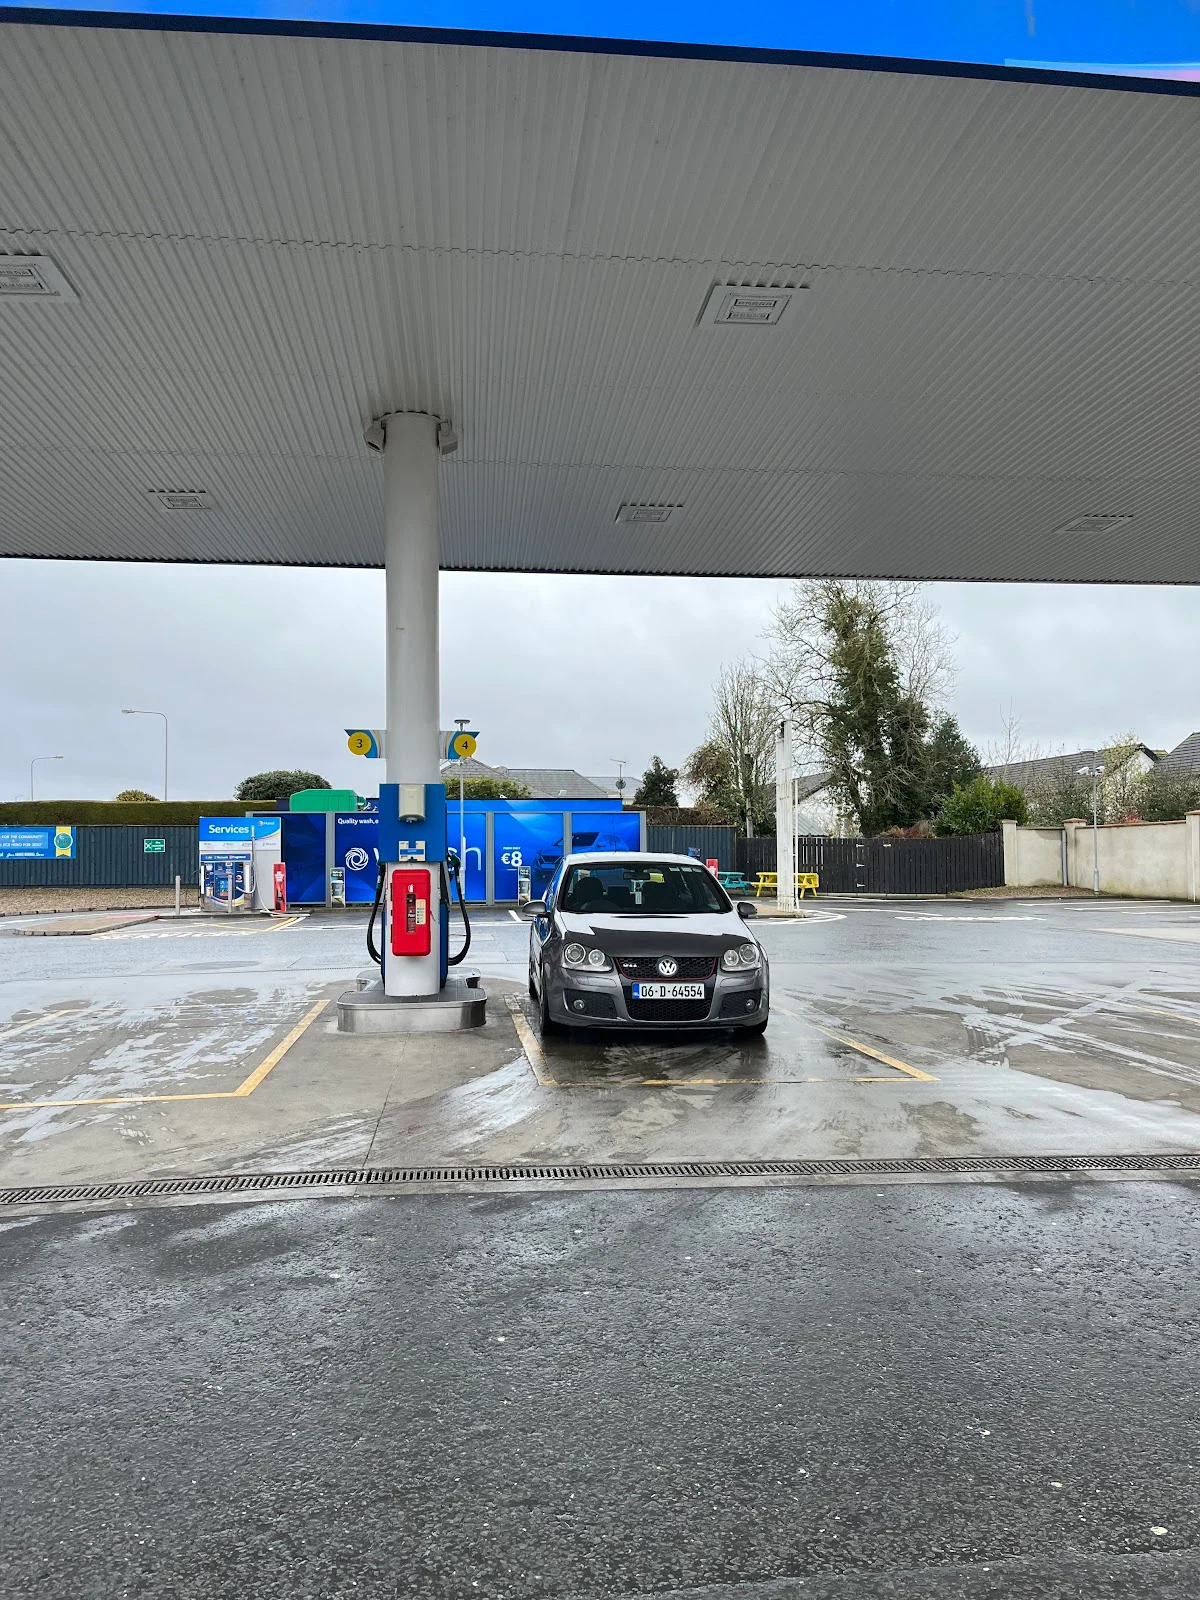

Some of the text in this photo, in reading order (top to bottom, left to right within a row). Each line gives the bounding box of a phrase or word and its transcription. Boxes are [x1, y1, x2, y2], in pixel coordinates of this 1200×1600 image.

[356, 738, 363, 749] 3
[462, 740, 469, 750] 4
[208, 824, 250, 834] Services
[501, 850, 523, 867] €8
[641, 985, 703, 998] 06-D-64554
